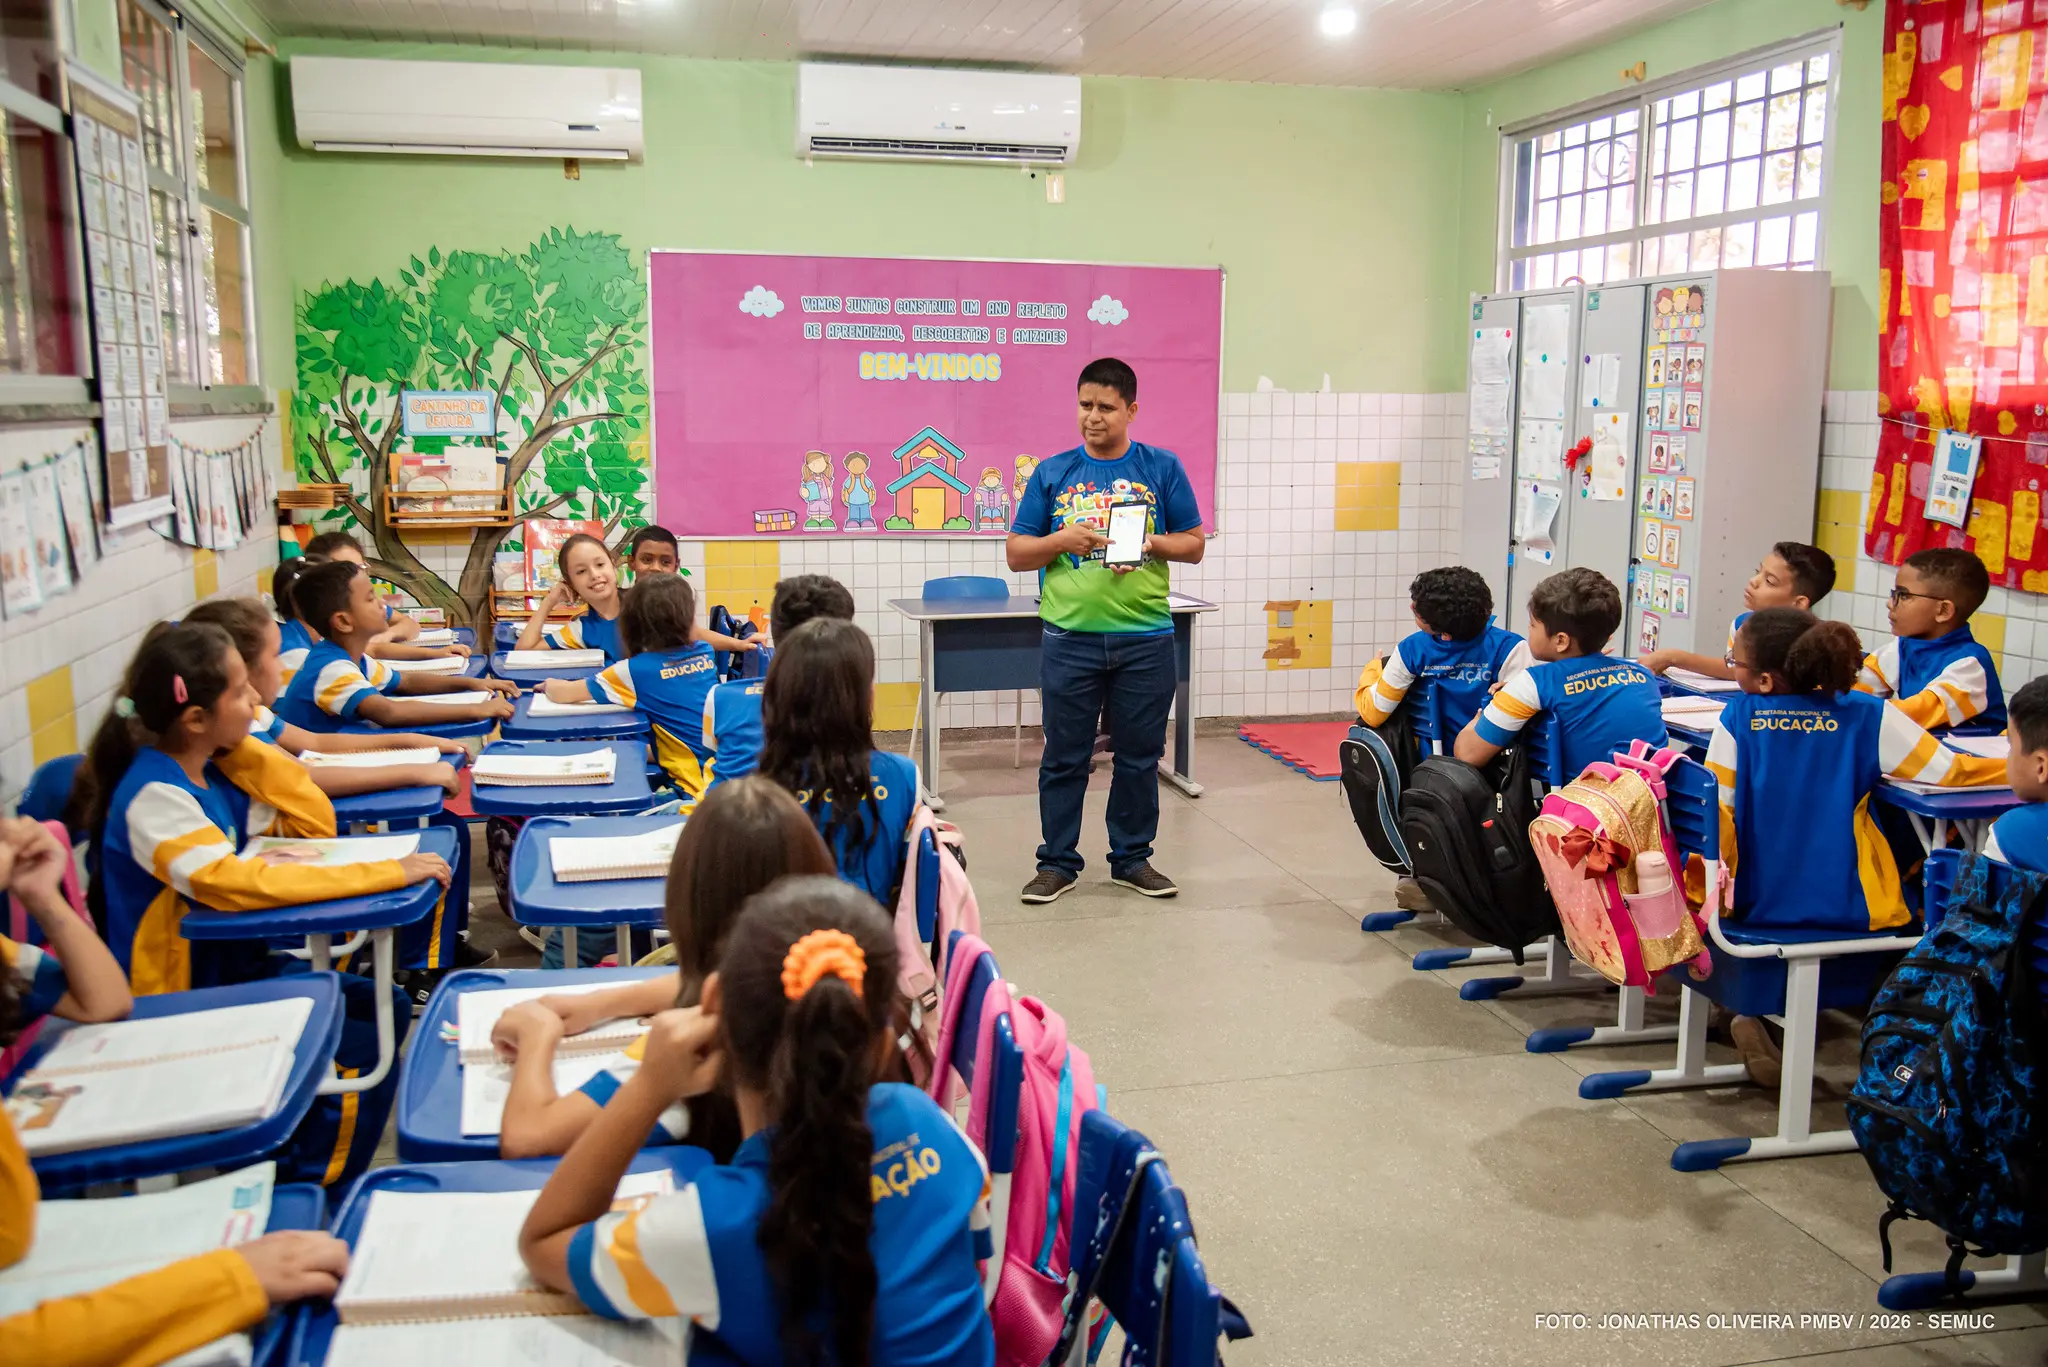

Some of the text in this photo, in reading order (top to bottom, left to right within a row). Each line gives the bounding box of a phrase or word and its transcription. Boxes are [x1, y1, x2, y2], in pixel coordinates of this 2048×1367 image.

[802, 297, 1066, 318] VAMOS JUNTOS CONSTRUIR UM ANO REPLETO
[805, 323, 1066, 344] DE APRENDIZADO, DESCOBERTAS E AMIZADES
[860, 352, 1001, 380] BEM-VINDOS
[412, 400, 487, 413] CANTINHO DA
[427, 415, 472, 428] LEITURA
[660, 659, 714, 680] EDUCAÇÃO
[1563, 670, 1647, 695] EDUCAÇÃO
[1750, 716, 1838, 734] EDUCAÇÃO
[870, 1147, 941, 1205] AÇÃO
